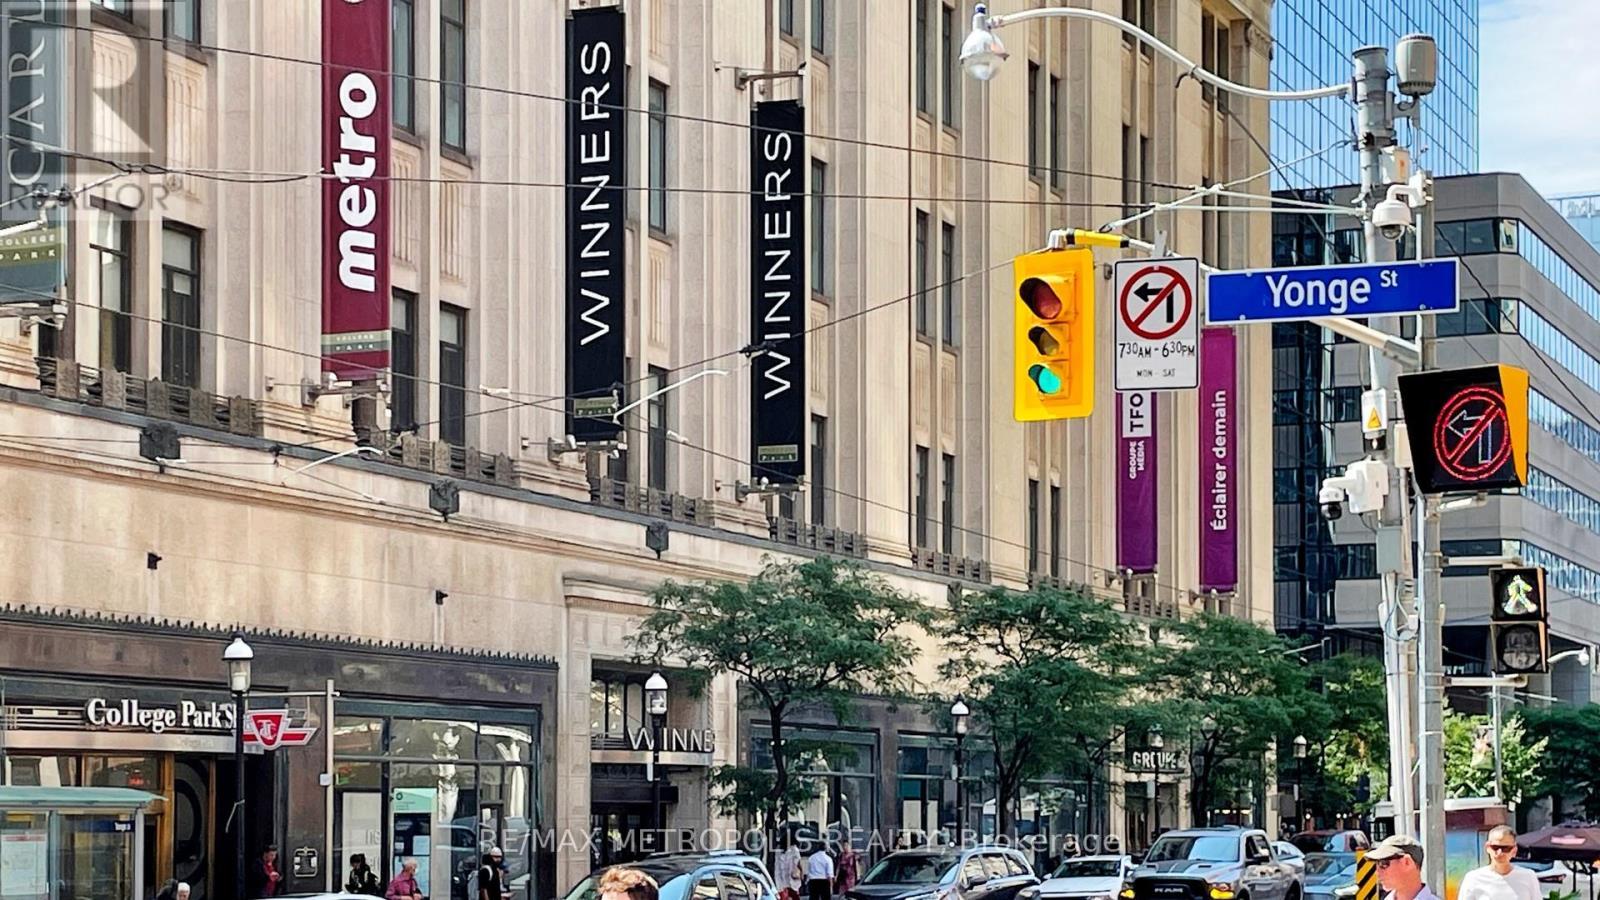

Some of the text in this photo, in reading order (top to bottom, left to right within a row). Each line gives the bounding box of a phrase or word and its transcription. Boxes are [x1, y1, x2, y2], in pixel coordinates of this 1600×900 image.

[332, 72, 377, 293] metro
[580, 41, 612, 346] WINNERS
[764, 131, 792, 401] WINNERS
[1265, 269, 1398, 314] Yonge St
[1136, 369, 1153, 377] MON
[1162, 367, 1176, 378] SAT
[1129, 392, 1144, 433] TFO
[1129, 441, 1137, 480] GROUPE
[1210, 390, 1227, 531] Éclairer demain
[87, 698, 176, 734] College
[181, 700, 222, 729] Park
